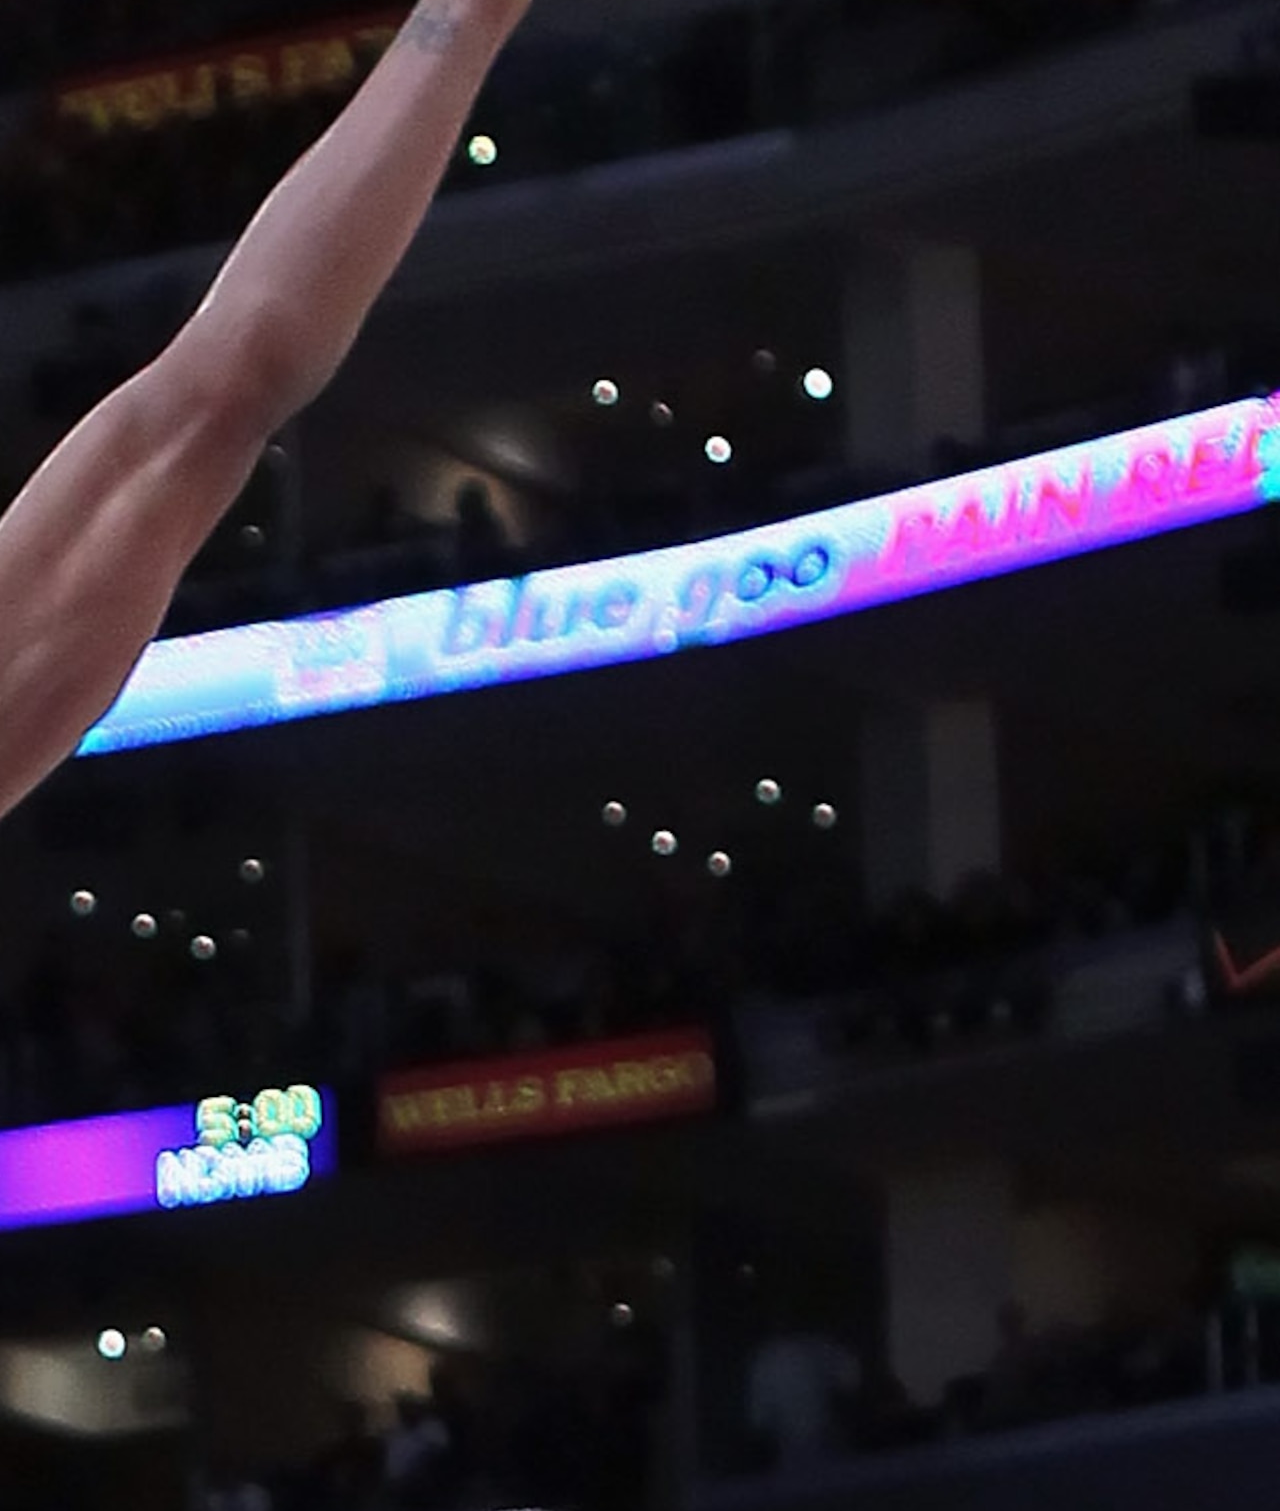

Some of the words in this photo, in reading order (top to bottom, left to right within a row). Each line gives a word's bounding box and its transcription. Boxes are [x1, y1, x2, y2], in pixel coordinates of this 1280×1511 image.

[440, 577, 638, 657] blue
[670, 542, 833, 639] goo
[878, 455, 1092, 575] PAIN
[196, 1085, 320, 1145] 5:00
